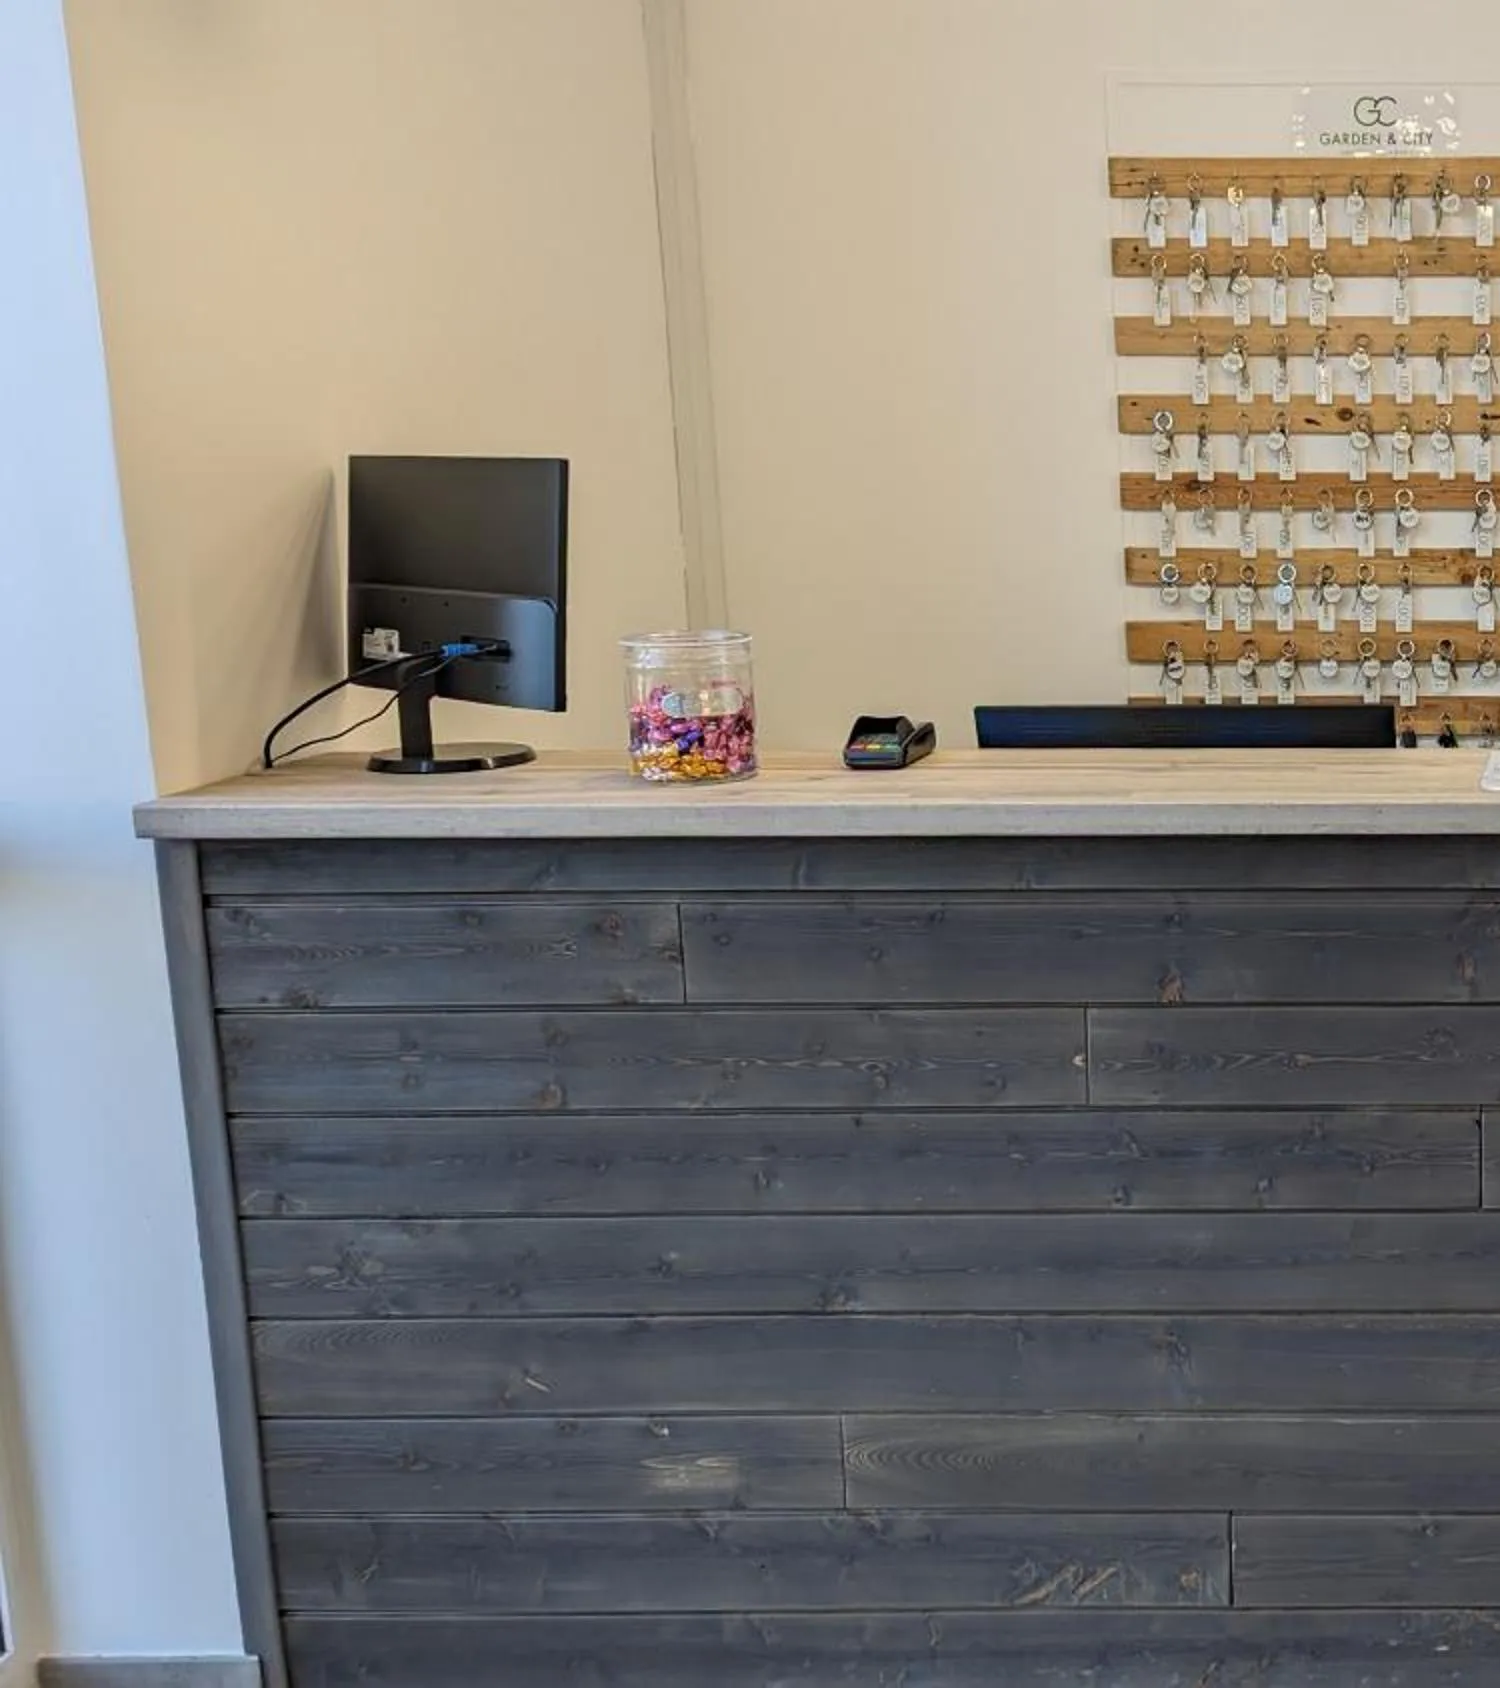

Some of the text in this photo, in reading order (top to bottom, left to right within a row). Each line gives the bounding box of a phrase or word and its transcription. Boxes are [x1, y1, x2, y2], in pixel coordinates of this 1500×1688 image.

[1353, 96, 1398, 127] GC
[1319, 131, 1434, 146] GARDEN & CITY
